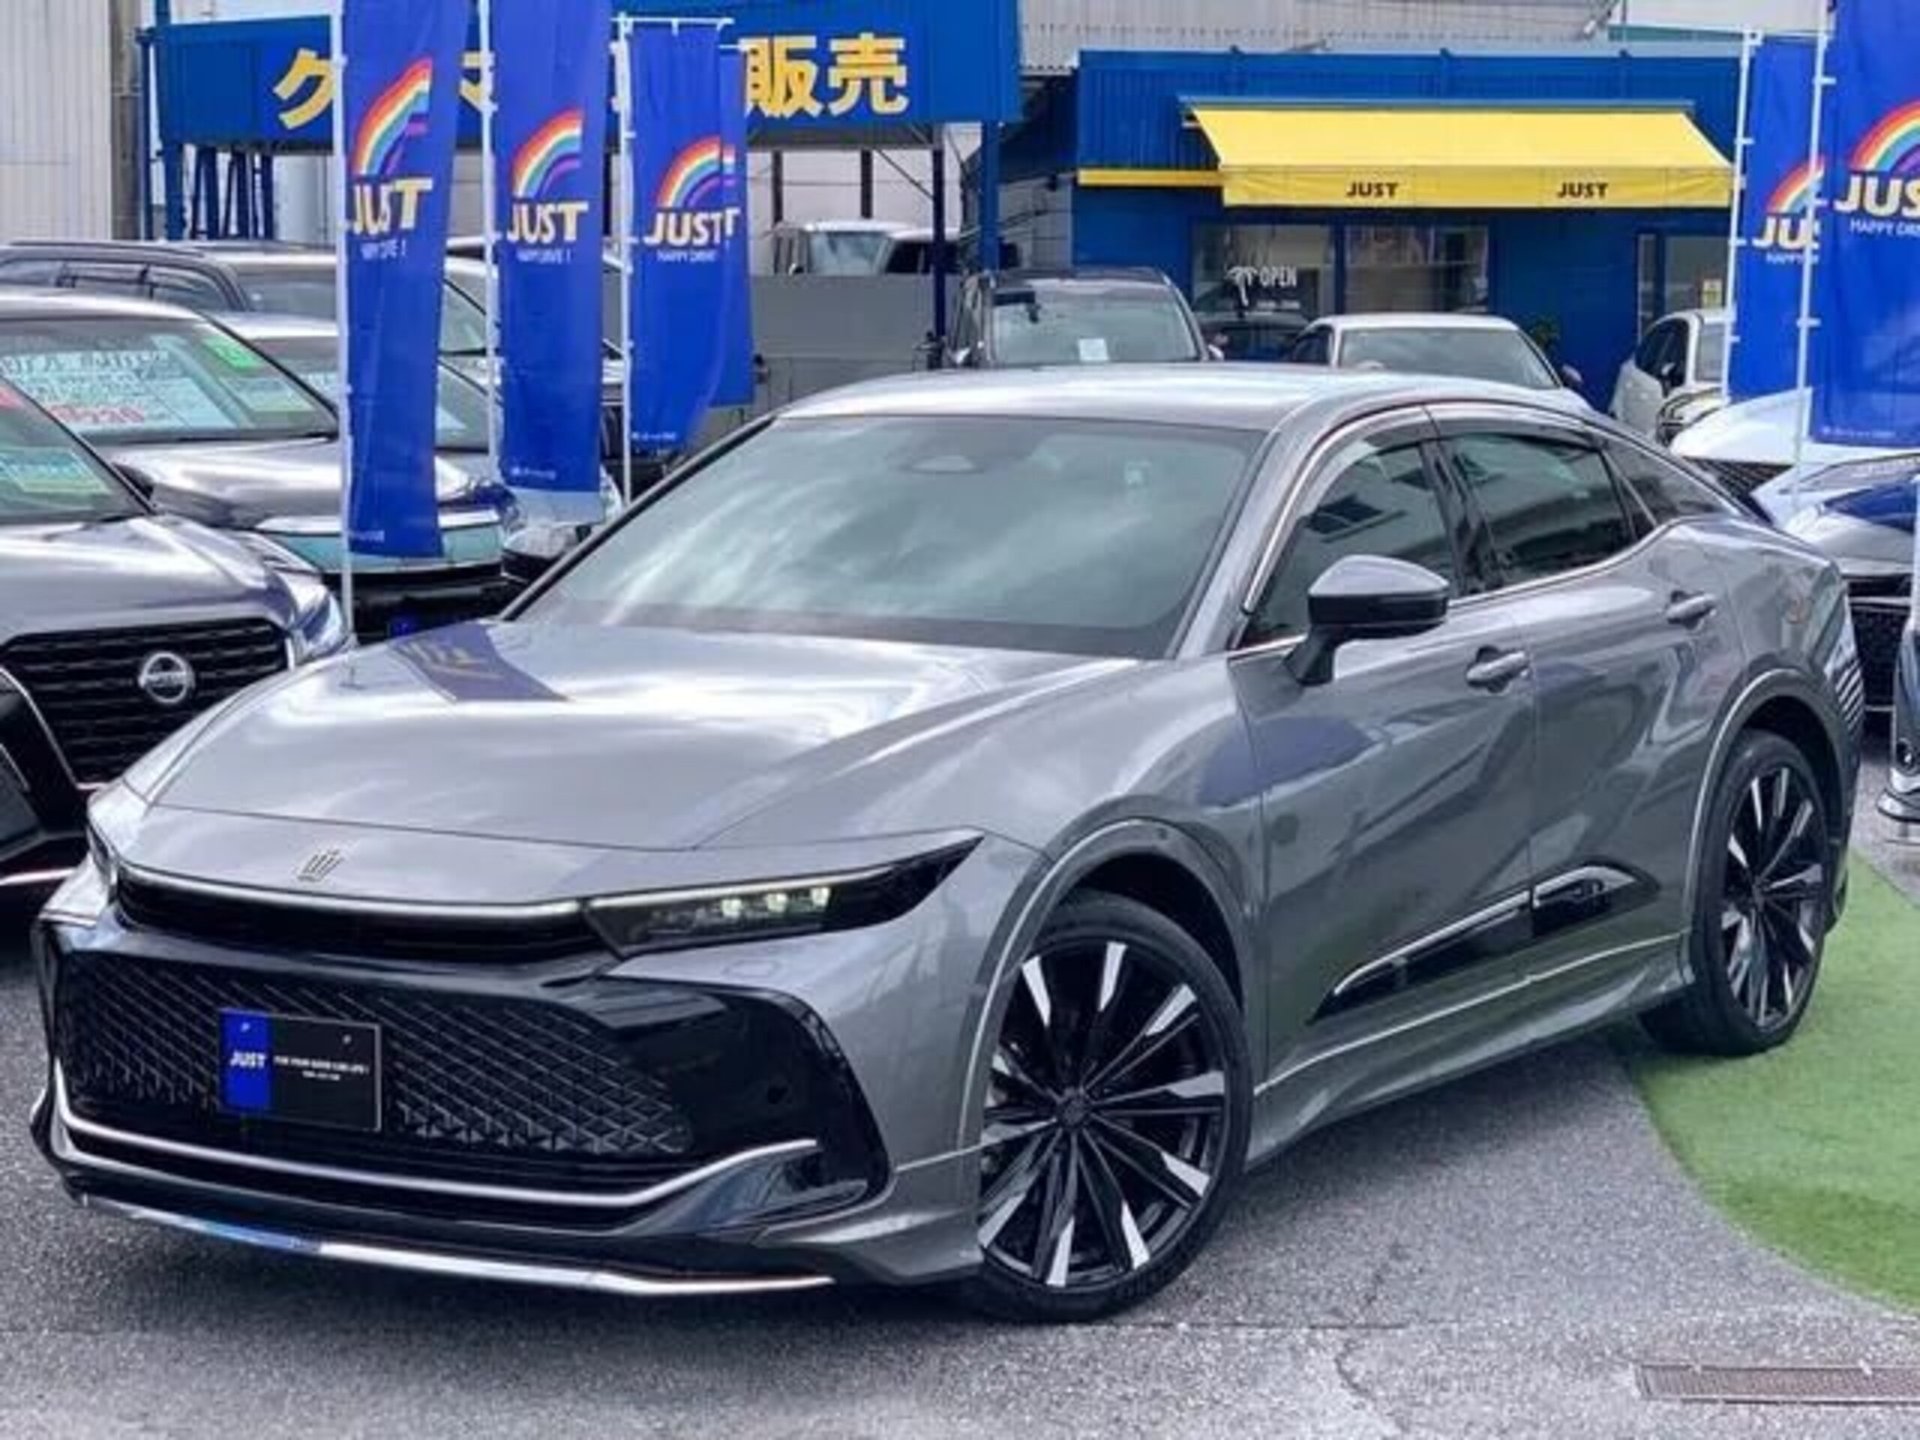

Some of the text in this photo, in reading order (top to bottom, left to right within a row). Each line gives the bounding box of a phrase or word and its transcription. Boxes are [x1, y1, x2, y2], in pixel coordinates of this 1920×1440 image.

[1346, 182, 1399, 198] JUST
[1557, 182, 1608, 198] JUST
[507, 201, 588, 243] JUST
[1260, 265, 1297, 287] OPEN
